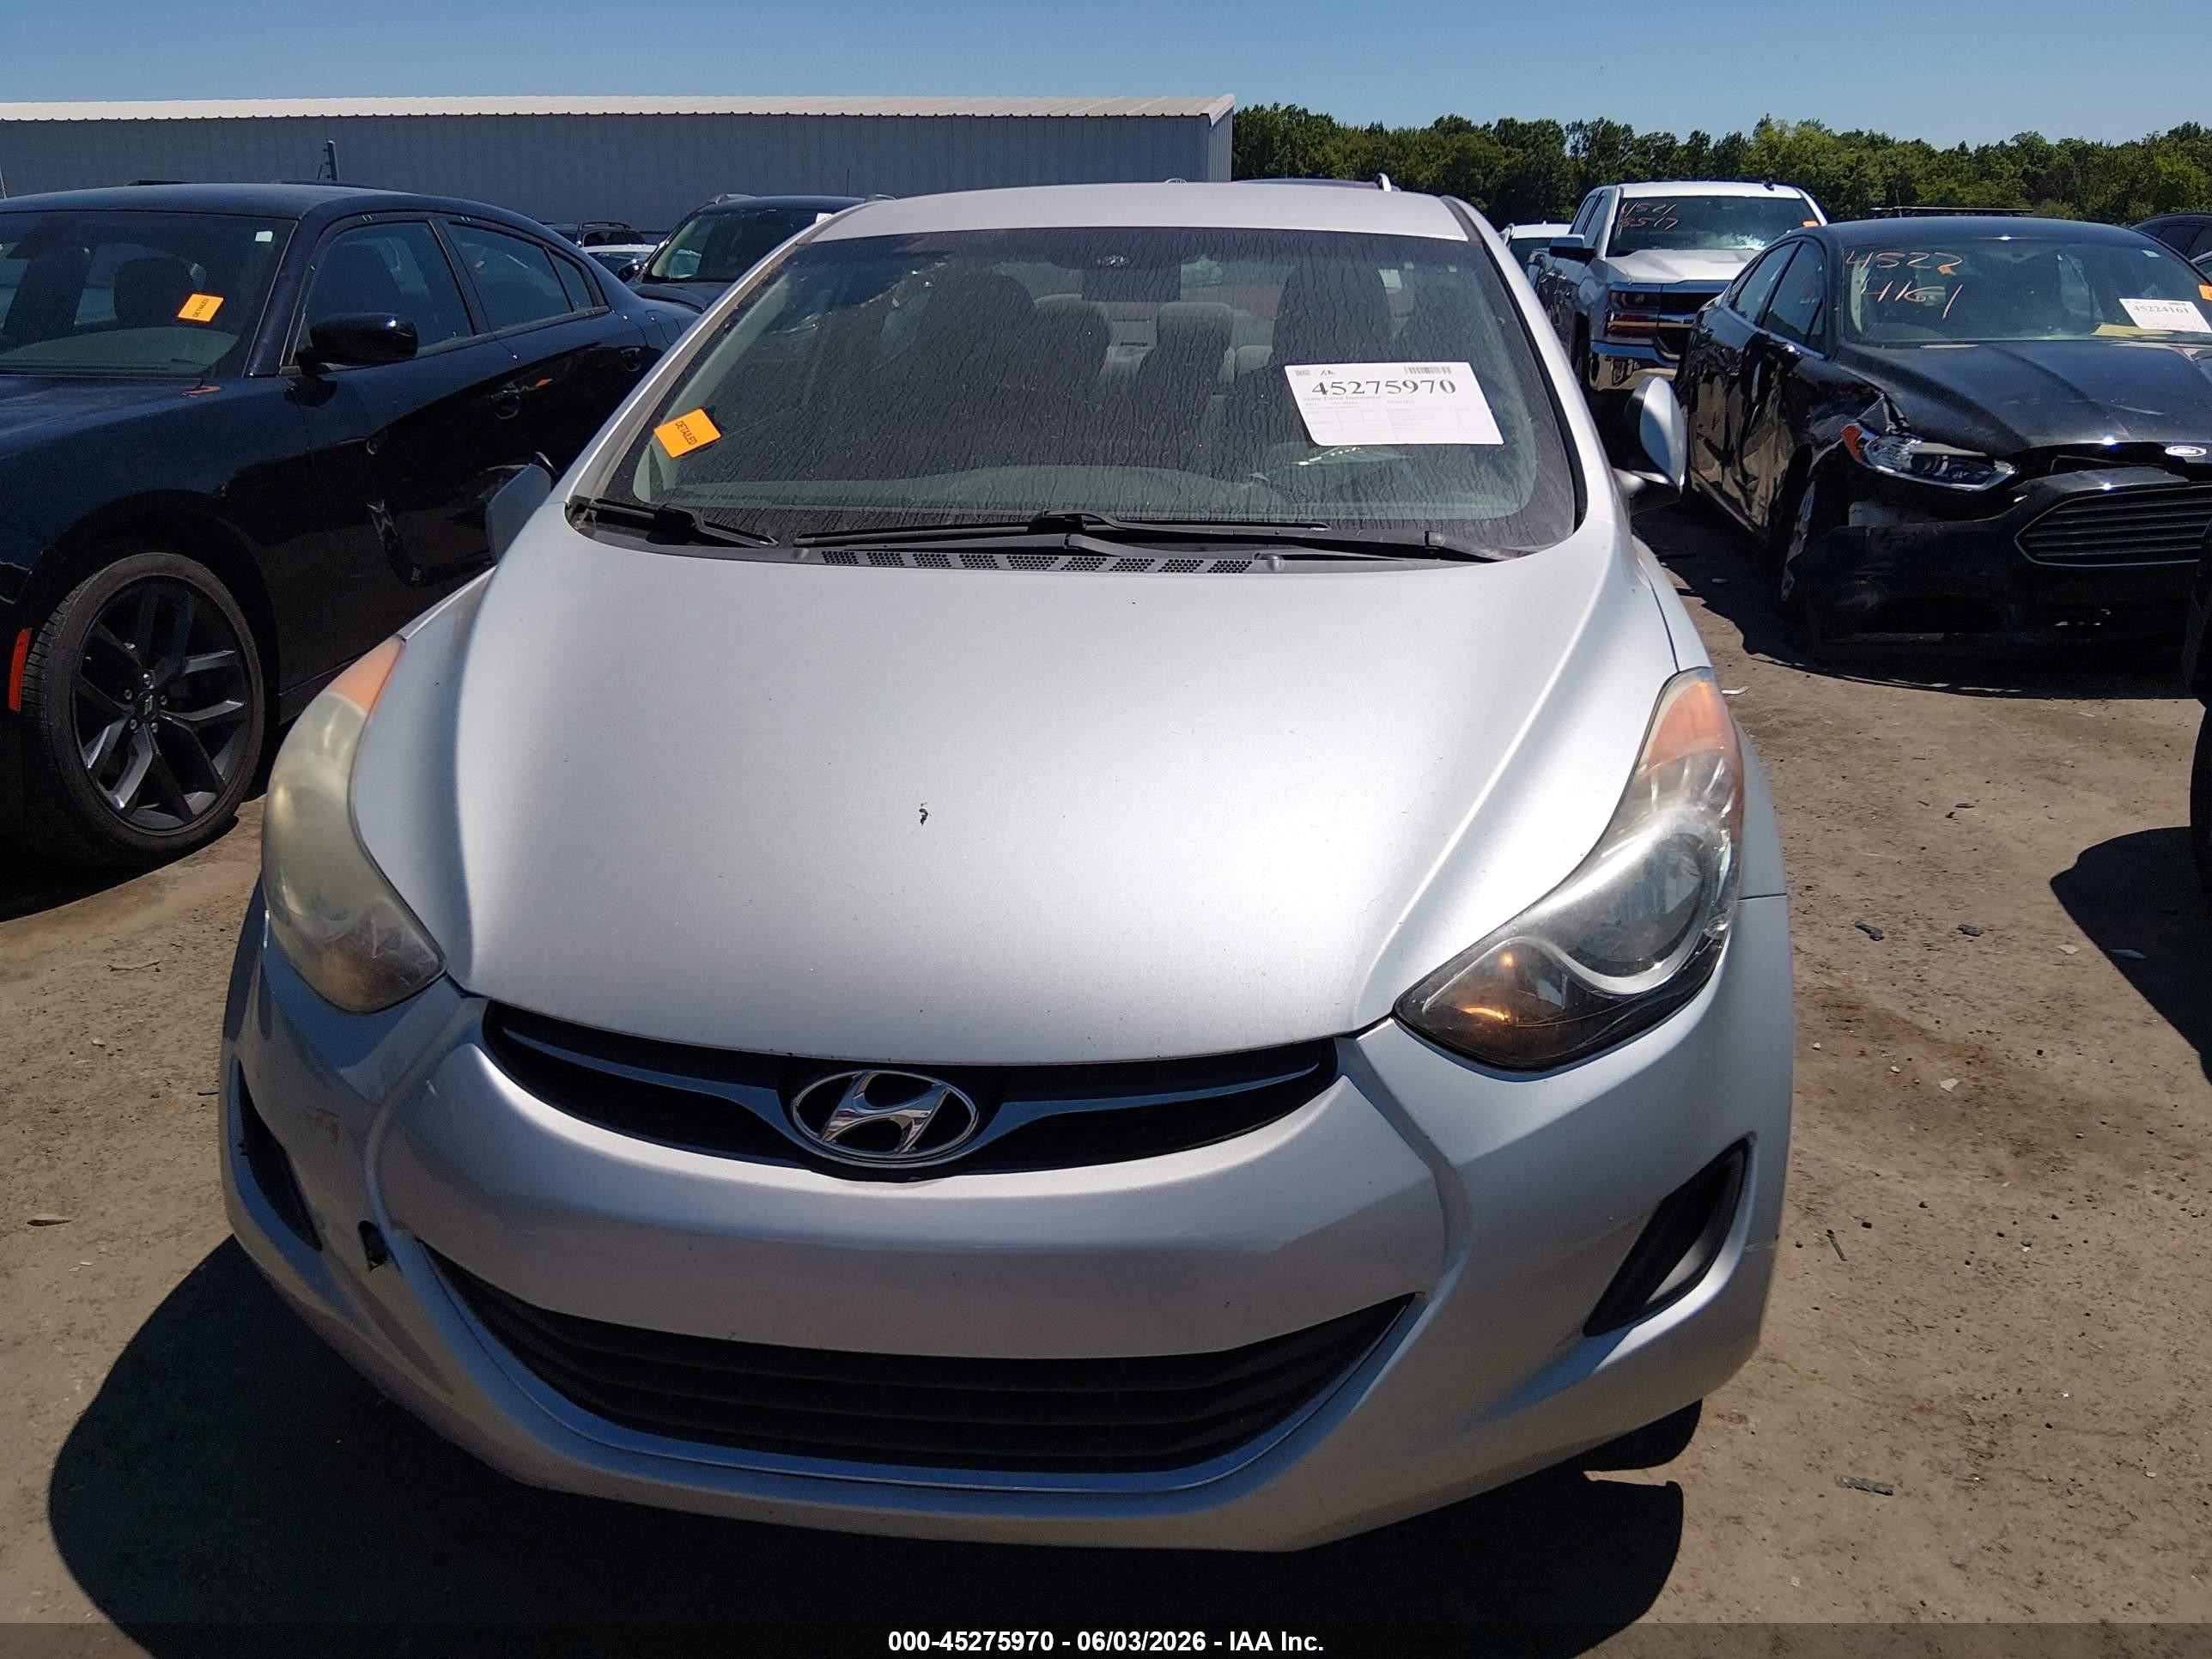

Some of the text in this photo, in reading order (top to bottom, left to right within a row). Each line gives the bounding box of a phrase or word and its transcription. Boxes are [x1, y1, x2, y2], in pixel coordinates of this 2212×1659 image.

[1846, 251, 1963, 273] 4522
[2134, 305, 2190, 313] 45224161
[1311, 379, 1456, 396] 45275970
[675, 420, 698, 446] DETAILED
